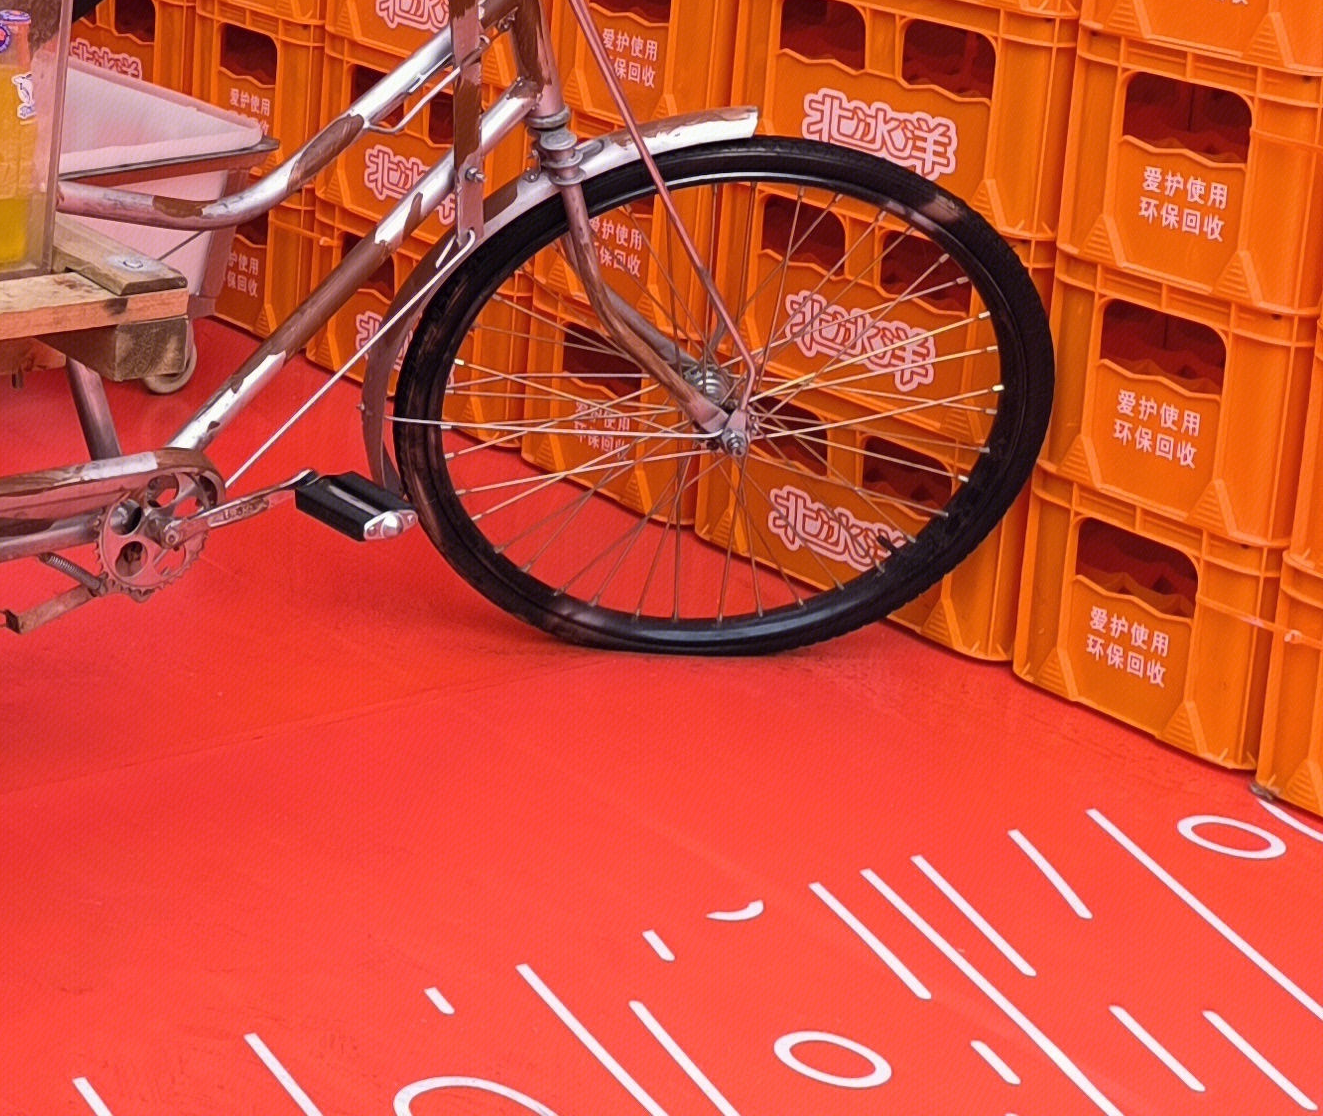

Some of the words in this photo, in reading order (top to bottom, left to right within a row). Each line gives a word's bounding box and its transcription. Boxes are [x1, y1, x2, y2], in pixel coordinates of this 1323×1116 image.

[602, 28, 658, 62] 爱护使用
[610, 55, 656, 89] 保回收
[802, 88, 957, 181] 北冰洋
[1141, 167, 1228, 210] 爱护使用
[1138, 196, 1224, 242] 环保回收
[228, 251, 259, 275] 护使用
[594, 241, 642, 278] 保回收
[224, 273, 259, 298] 保回收
[785, 289, 935, 392] 北冰洋
[1116, 390, 1201, 437] 爱护使用
[1113, 419, 1195, 469] 环保回收
[1090, 606, 1170, 658] 爱护使用
[1086, 634, 1166, 688] 环保回收
